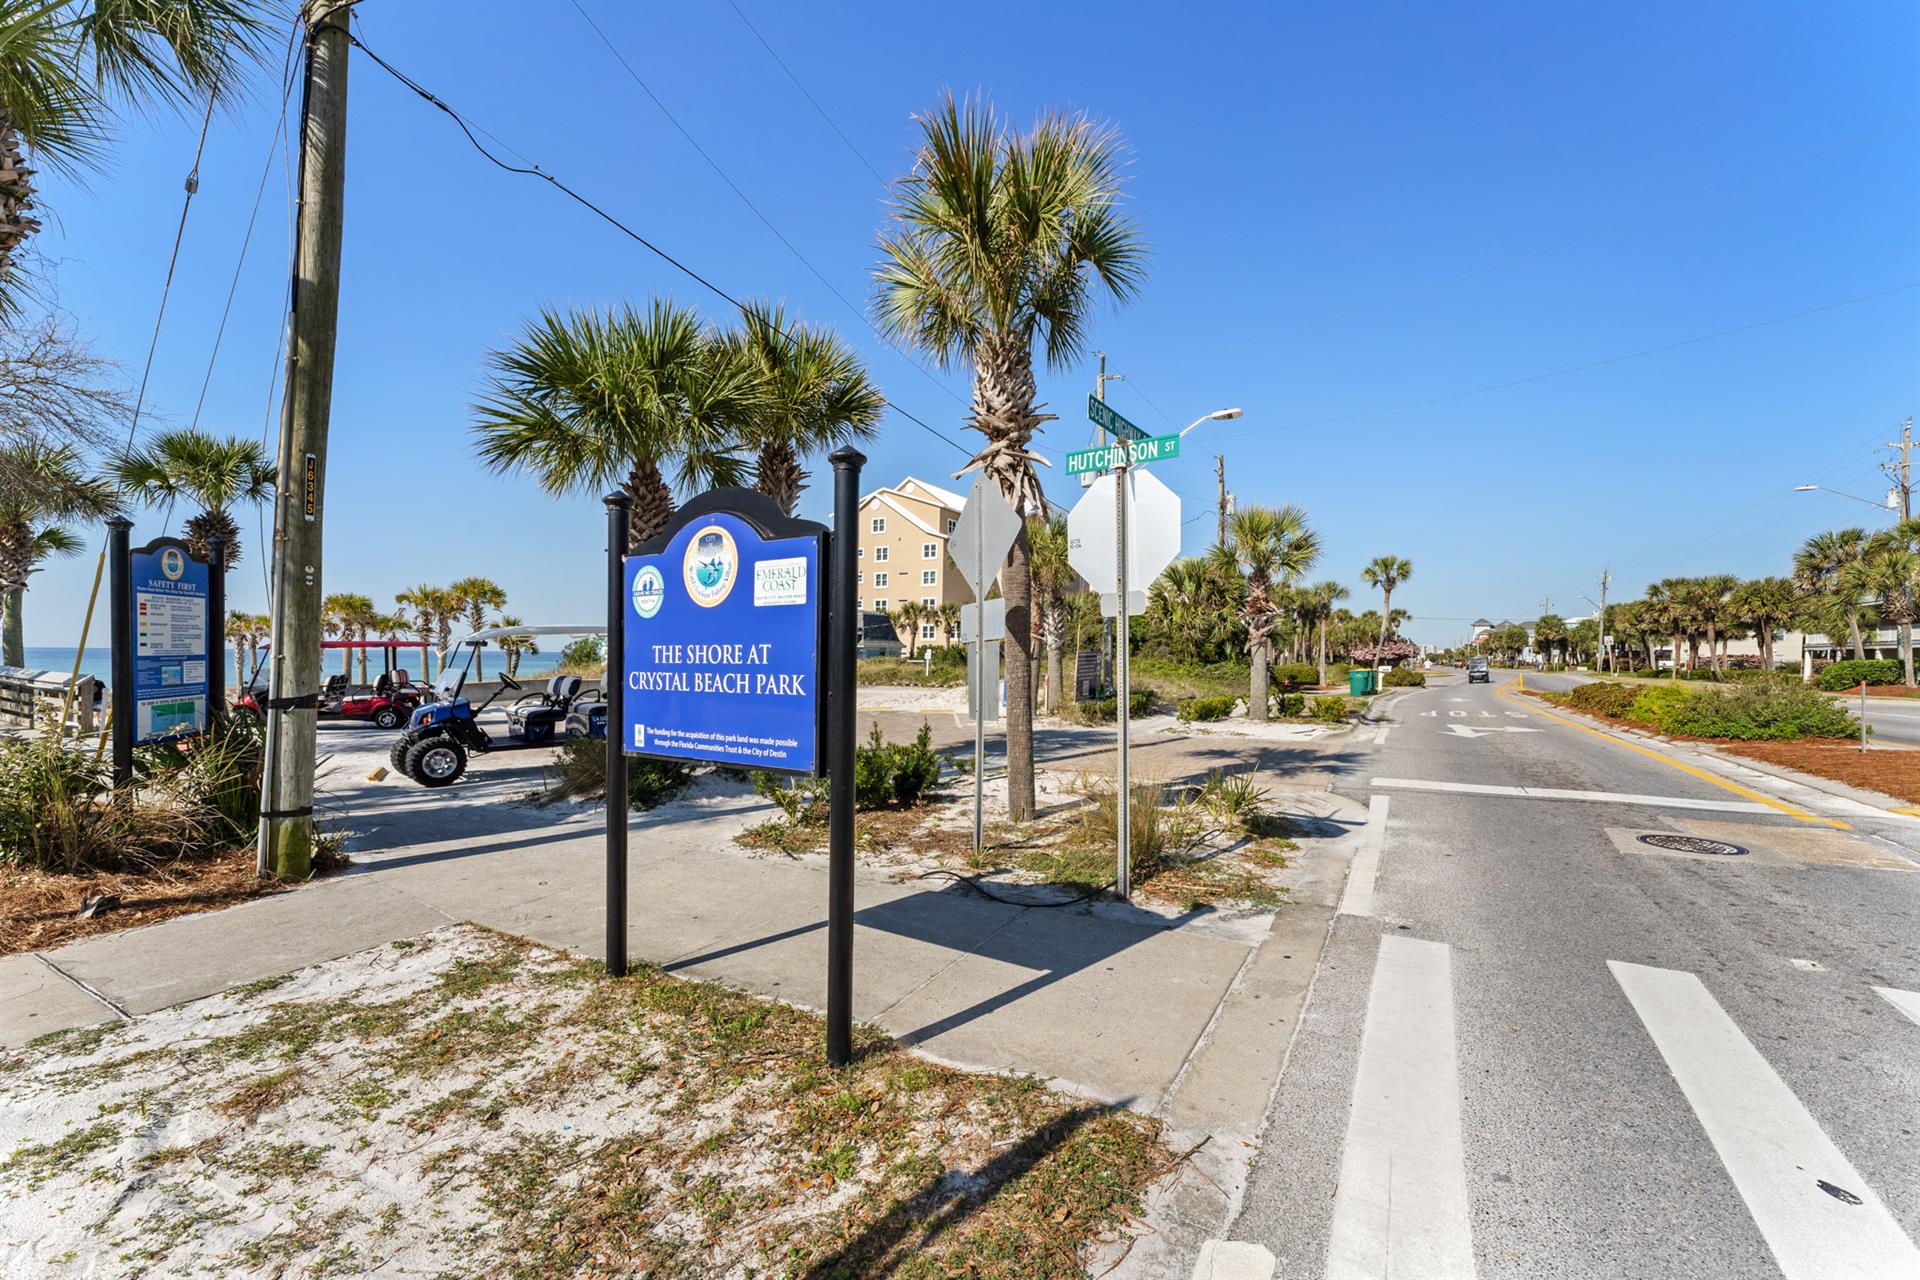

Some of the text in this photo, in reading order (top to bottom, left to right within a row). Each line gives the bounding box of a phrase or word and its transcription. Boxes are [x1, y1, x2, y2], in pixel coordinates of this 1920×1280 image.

[1089, 399, 1114, 430] SCENIC
[1068, 440, 1176, 472] HUTCHINSON ST
[306, 459, 315, 514] J6345
[756, 566, 806, 580] EMERALD
[148, 579, 176, 589] SAFETY
[177, 582, 196, 591] FIRST
[762, 579, 797, 591] COAST
[652, 644, 772, 665] THE SHORE AT
[629, 671, 807, 696] CRYSTAL BEACH PARK
[1420, 710, 1528, 718] STOP
[646, 727, 655, 735] The
[685, 731, 709, 740] acquisition
[710, 732, 716, 740] of
[716, 733, 724, 741] this
[725, 734, 736, 743] park
[737, 734, 748, 743] land
[760, 737, 774, 746] made
[775, 739, 798, 748] possible
[671, 739, 679, 747] the
[679, 740, 694, 749] Florida
[694, 742, 724, 752] Communities
[725, 745, 737, 753] Trust
[738, 746, 742, 754] &
[743, 746, 752, 755] the
[752, 748, 763, 757] City
[763, 749, 769, 757] of
[769, 749, 787, 758] Destin
